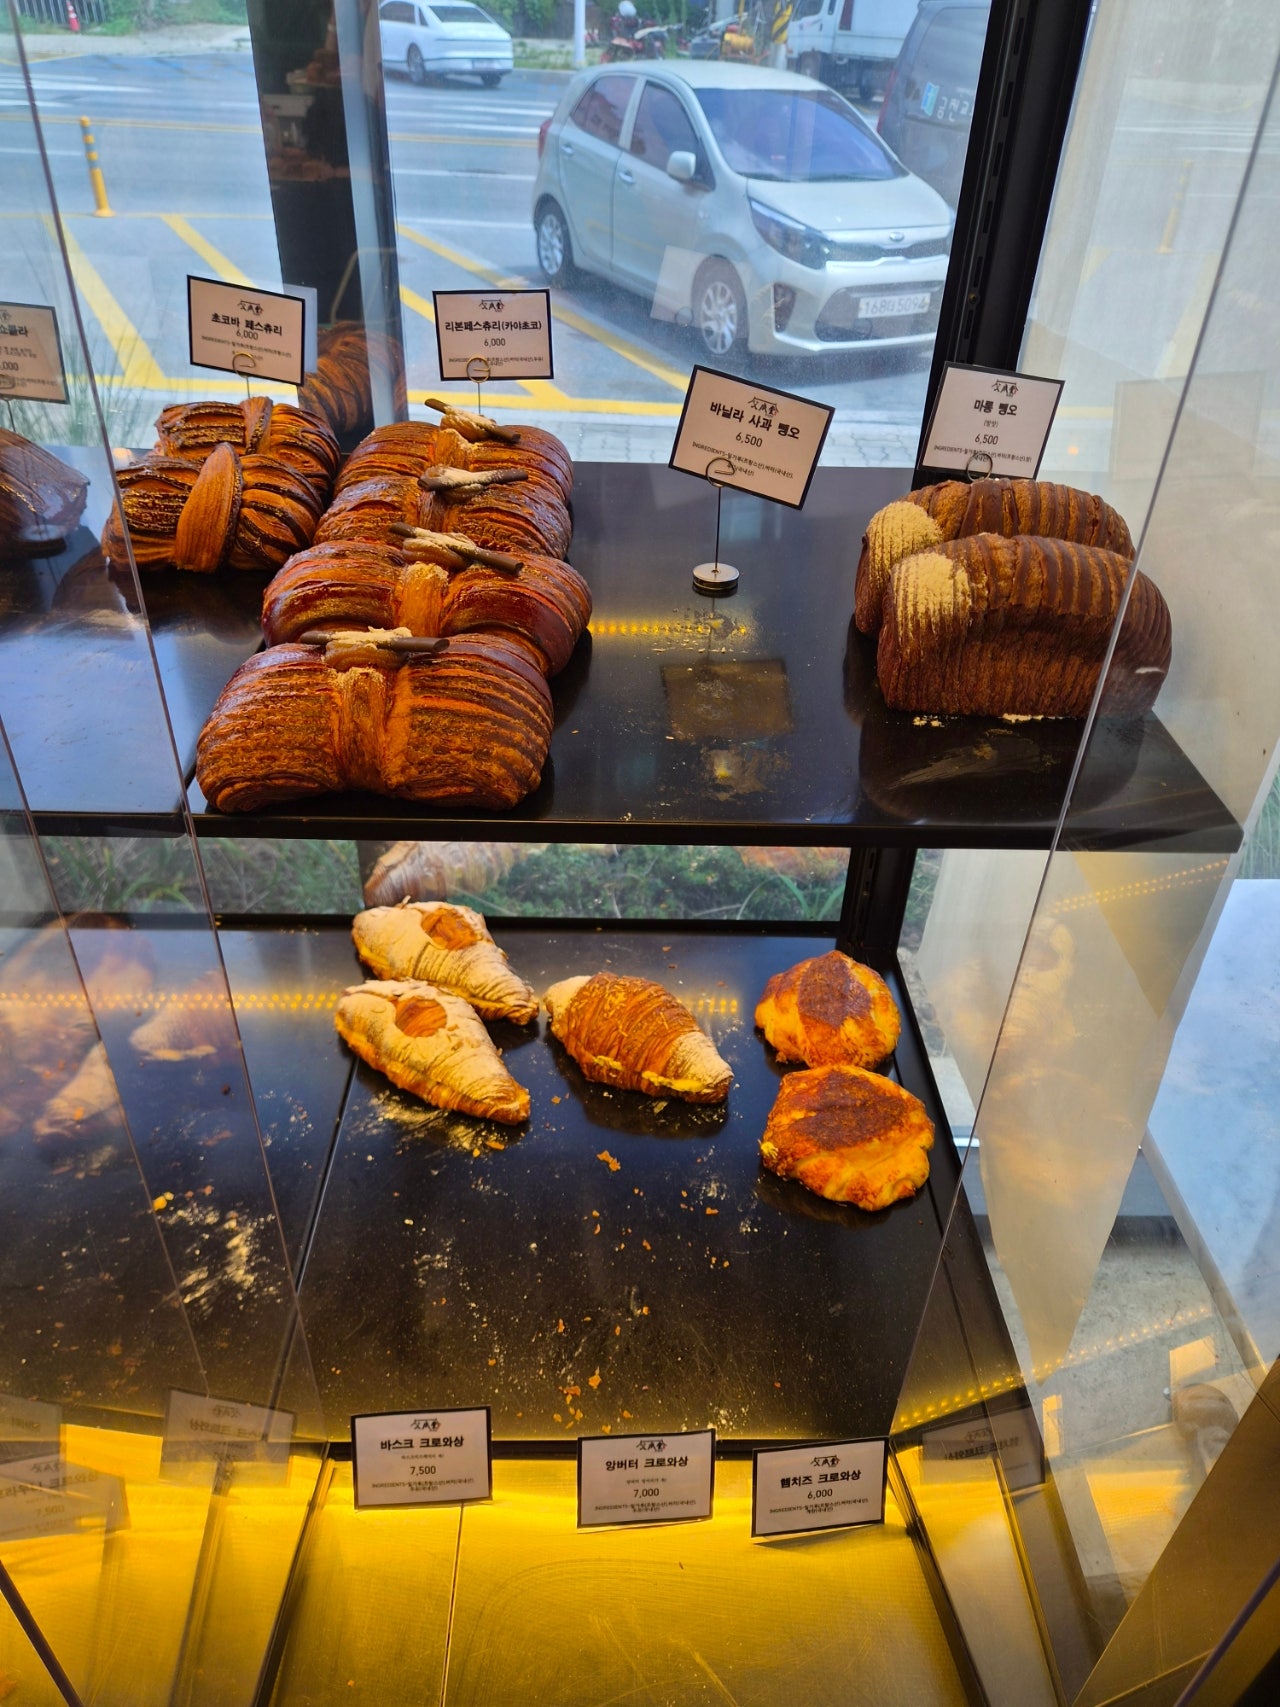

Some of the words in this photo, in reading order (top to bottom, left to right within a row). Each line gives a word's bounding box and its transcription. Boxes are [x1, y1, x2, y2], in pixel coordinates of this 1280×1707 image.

[937, 96, 974, 122] 금천교
[211, 312, 240, 328] 초코바
[244, 319, 283, 337] 페스츄리
[444, 320, 543, 332] 리본페스츄리(카야초코)
[236, 328, 259, 341] 6,000
[483, 337, 507, 349] 6,000
[973, 399, 994, 414] 마롱
[709, 401, 745, 423] 바닐라
[748, 414, 773, 432] 사과
[735, 431, 764, 449] 6,500
[974, 433, 999, 446] 6,500
[379, 1439, 414, 1451] 바스크
[419, 1436, 464, 1449] 크로와상
[409, 1465, 437, 1477] 7,500
[605, 1458, 639, 1472] 앙버터
[643, 1456, 688, 1468] 크로와상
[780, 1474, 813, 1489] 햄치즈
[817, 1469, 862, 1484] 크로와상
[633, 1487, 660, 1499] 7,000
[807, 1487, 834, 1500] 6,000
